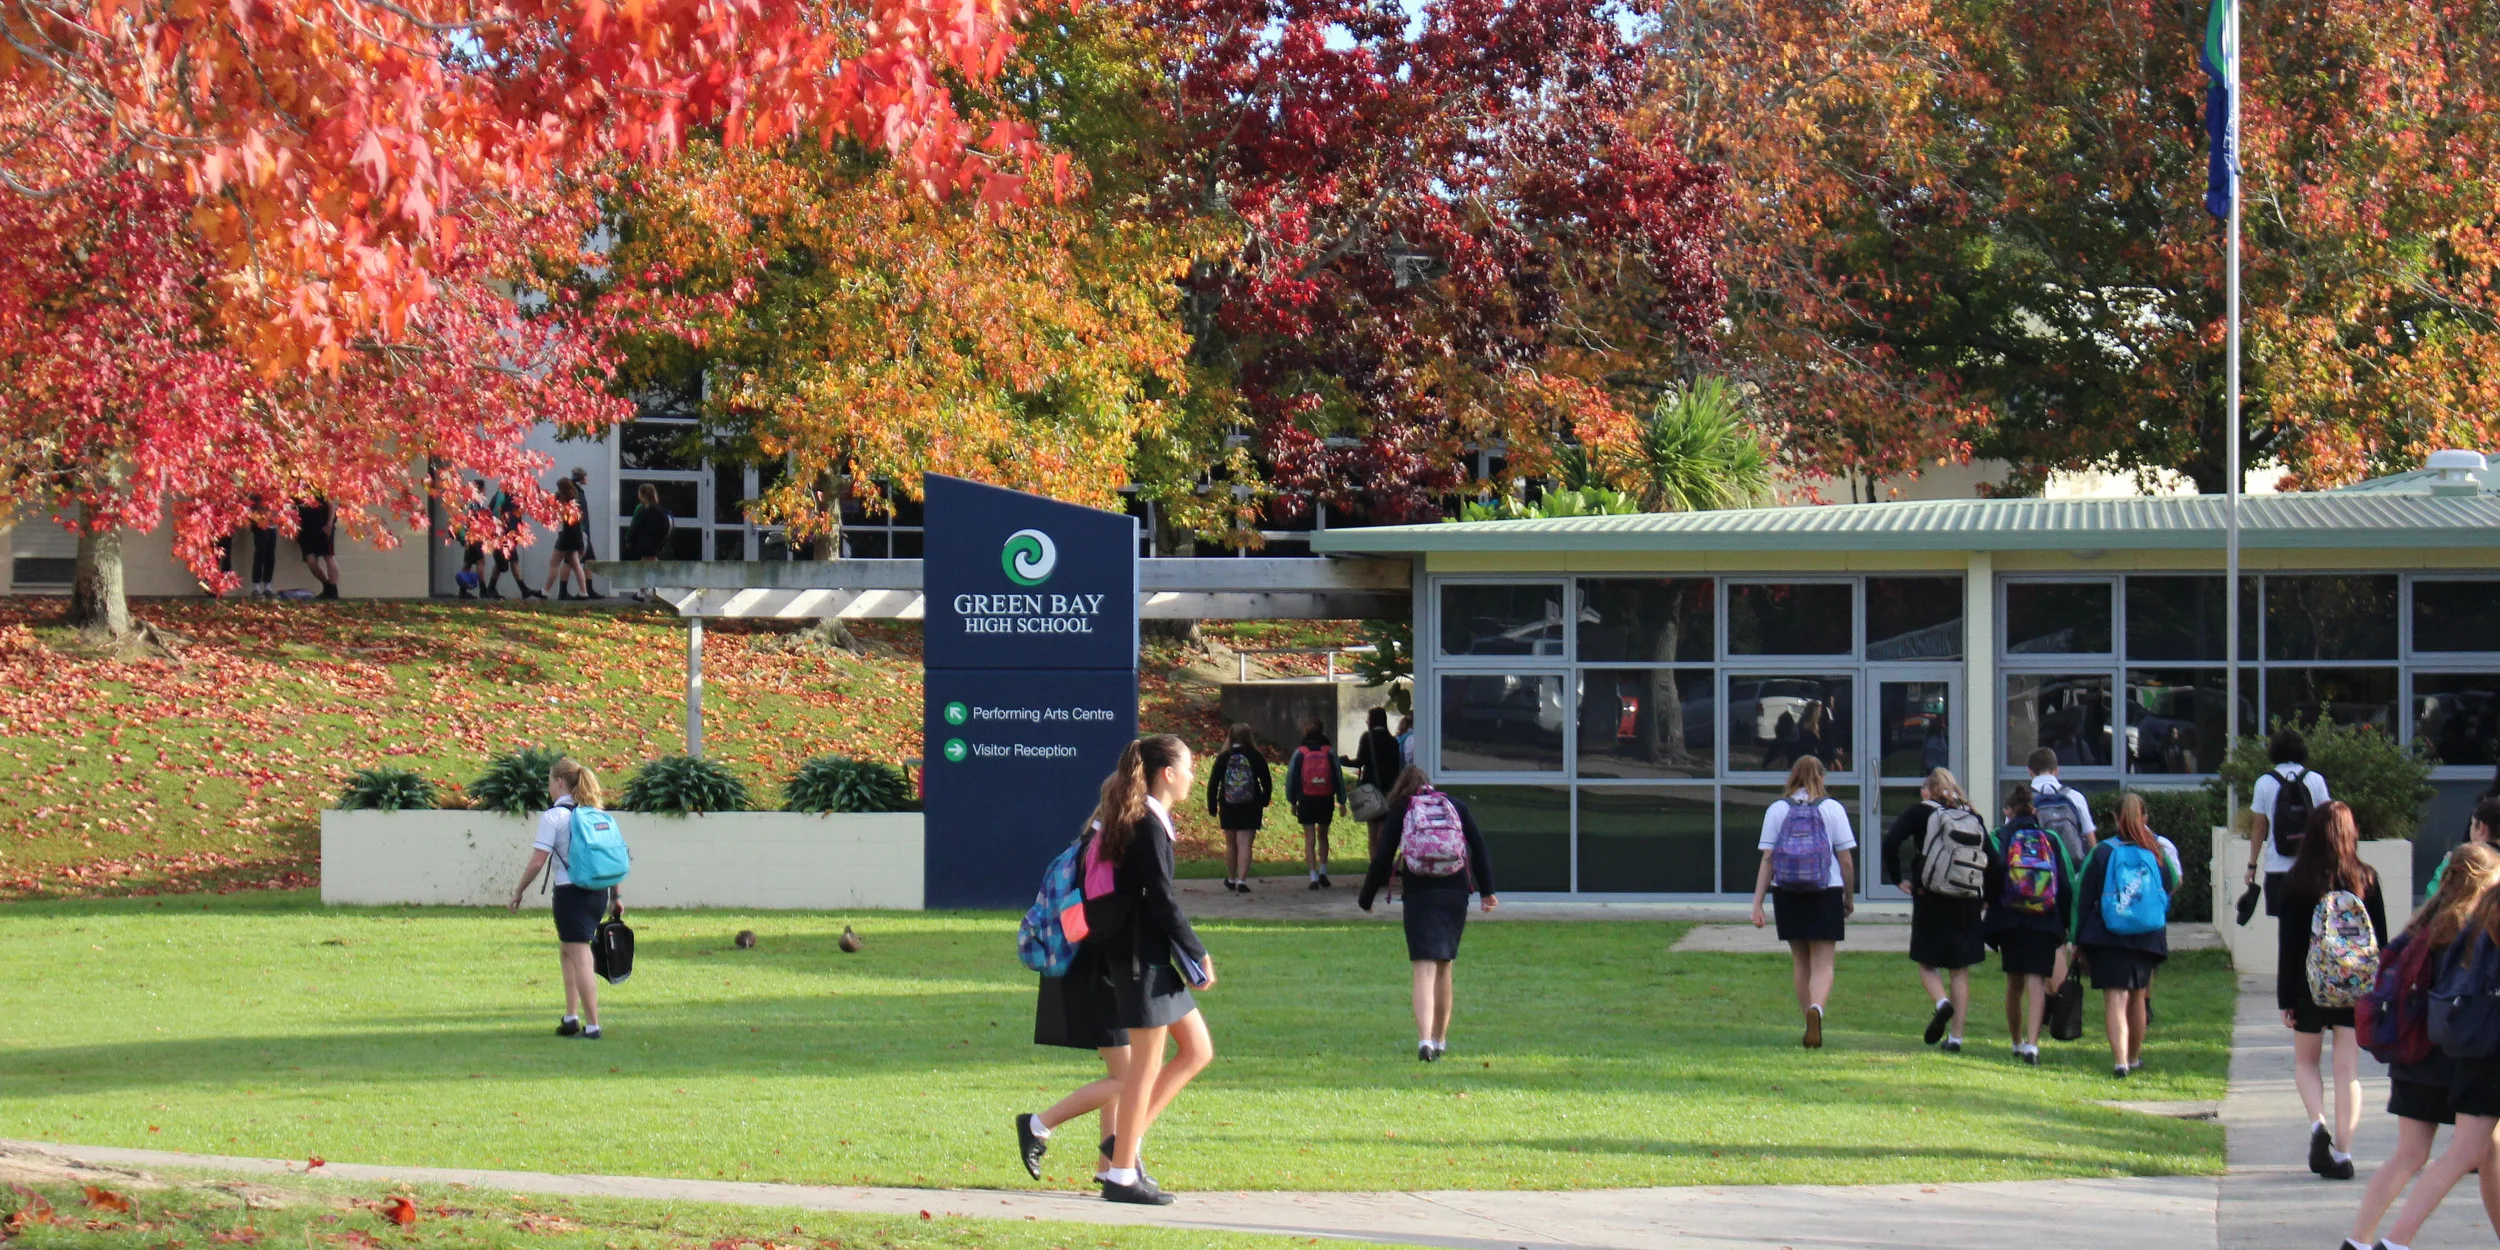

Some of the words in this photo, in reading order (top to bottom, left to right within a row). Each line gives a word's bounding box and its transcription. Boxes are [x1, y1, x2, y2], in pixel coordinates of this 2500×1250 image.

[953, 594, 1043, 615] GREEN
[1049, 594, 1105, 615] BAY
[964, 617, 1012, 633] HIGH
[1016, 617, 1093, 633] SCHOOL
[972, 706, 1040, 723] Performing
[1043, 707, 1069, 720] Arts
[1072, 707, 1114, 720] Centre
[972, 744, 1011, 757] Visitor
[1014, 744, 1077, 759] Reception
